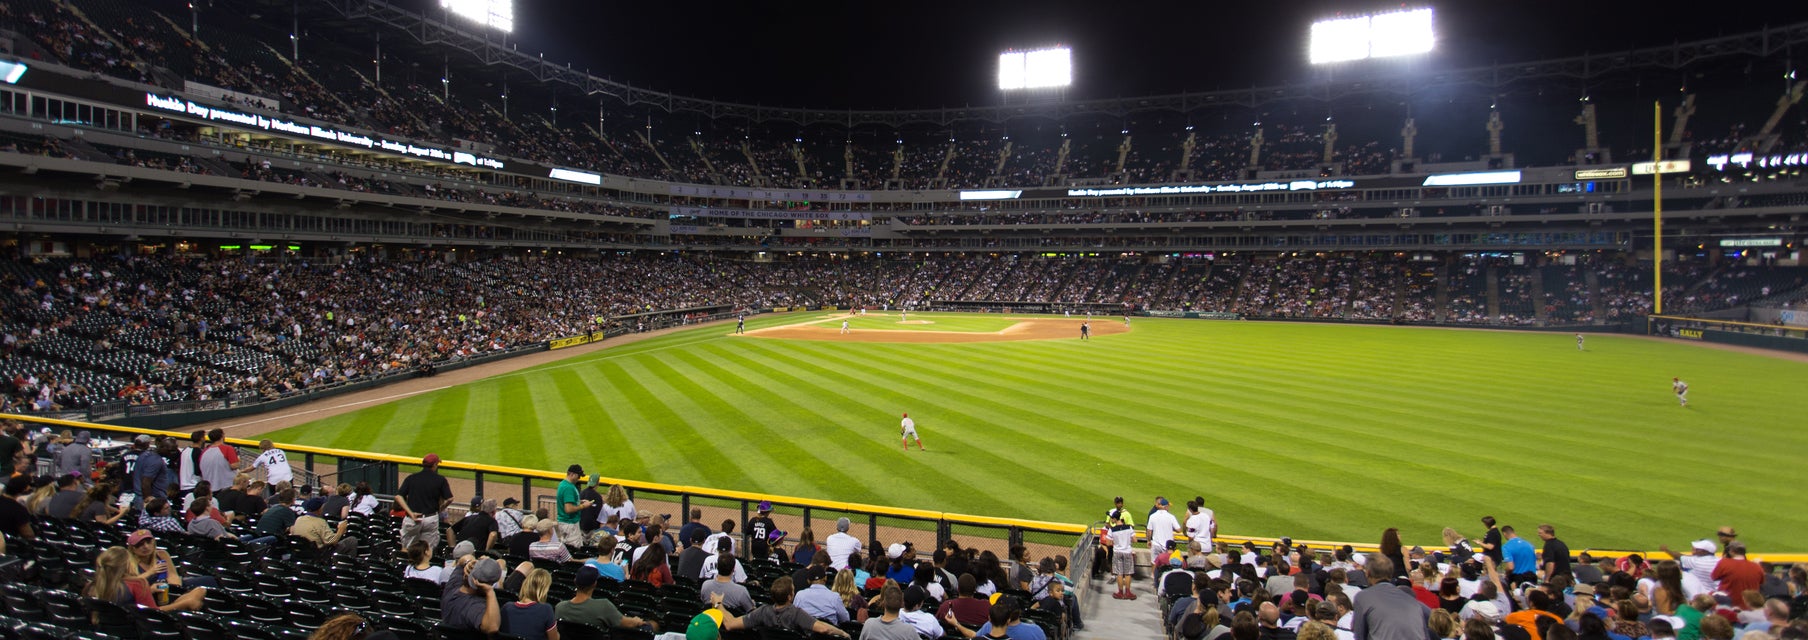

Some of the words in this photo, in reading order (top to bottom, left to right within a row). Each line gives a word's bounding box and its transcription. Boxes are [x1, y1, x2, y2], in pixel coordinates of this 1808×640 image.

[146, 92, 186, 112] Huskie
[186, 101, 210, 119] Day
[209, 109, 257, 126] presented
[258, 115, 271, 129] by
[271, 118, 310, 135] Northern
[310, 126, 337, 140] Illinois
[337, 131, 374, 148] University
[407, 144, 430, 156] August
[269, 454, 285, 464] 43
[125, 461, 136, 475] 14
[754, 527, 766, 539] 79
